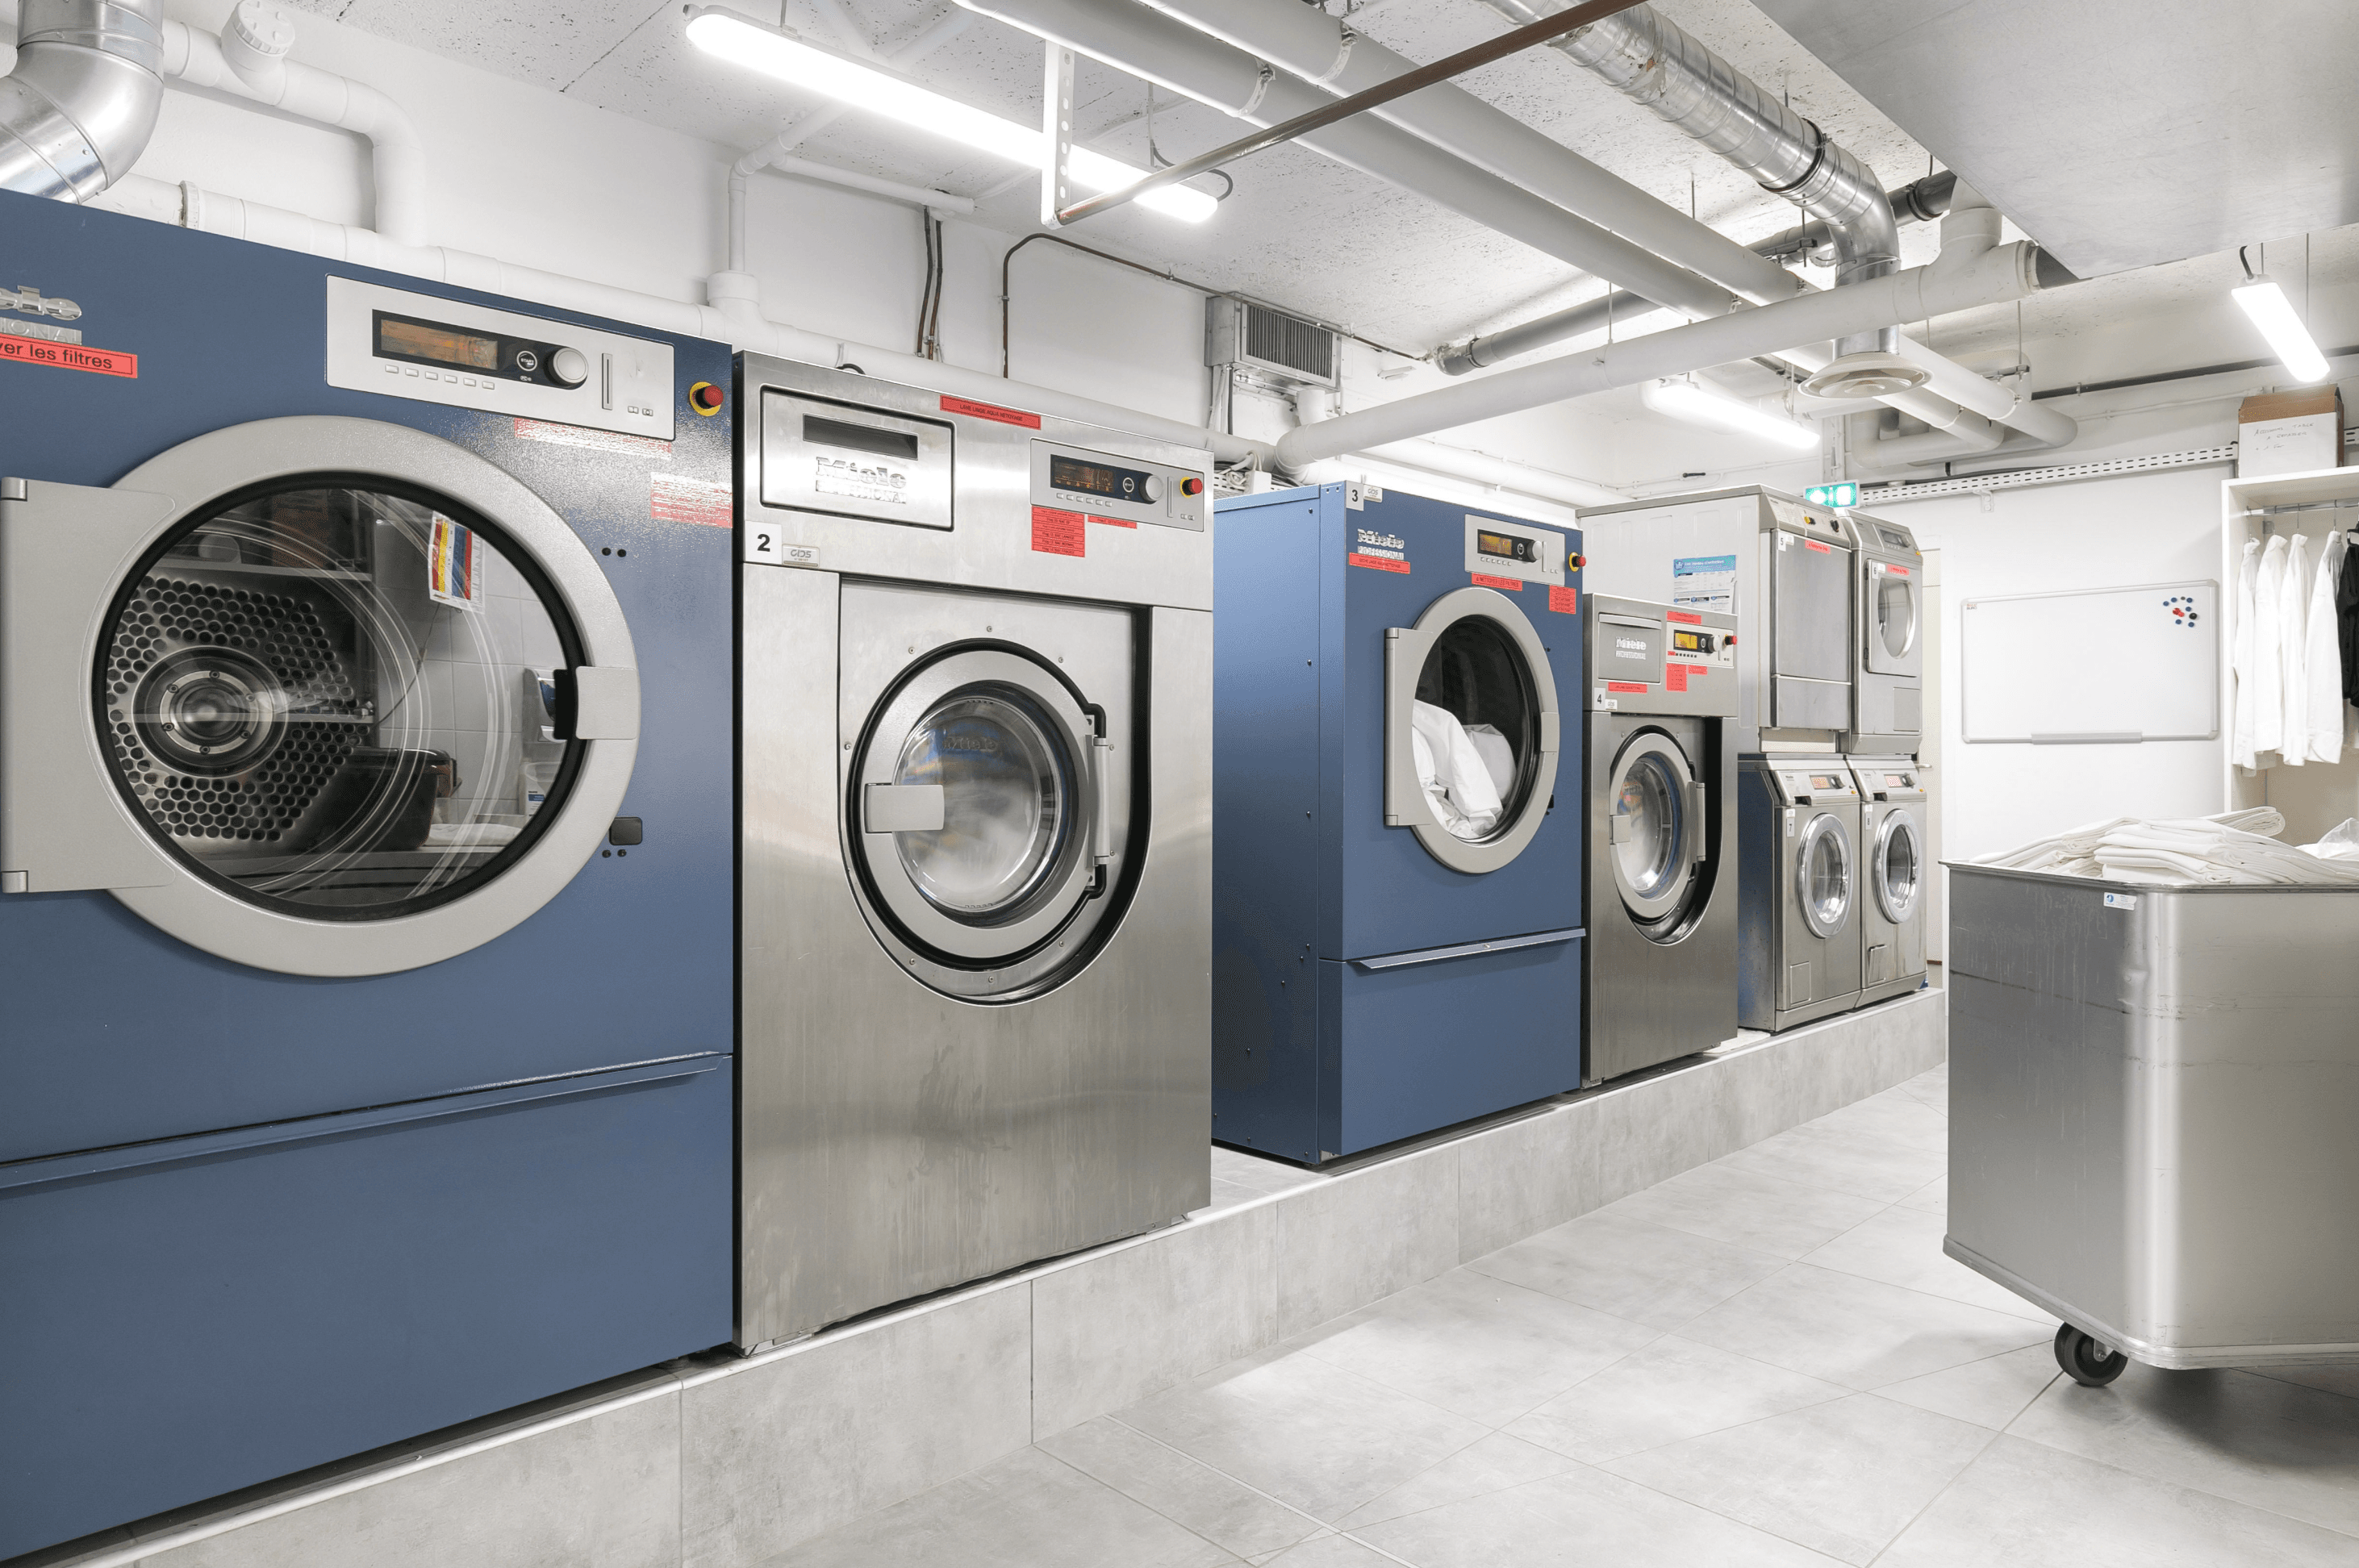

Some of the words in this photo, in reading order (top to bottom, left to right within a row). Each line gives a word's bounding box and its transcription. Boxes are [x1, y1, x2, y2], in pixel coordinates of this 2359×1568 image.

[30, 344, 56, 361] les
[63, 349, 113, 369] filtres
[816, 457, 907, 489] Miele
[1351, 489, 1359, 502] 3
[757, 533, 770, 552] 2
[1357, 528, 1405, 549] Miele
[1780, 537, 1784, 545] 5
[1616, 636, 1647, 650] Miele
[1597, 694, 1602, 704] 4
[1789, 824, 1793, 832] 7
